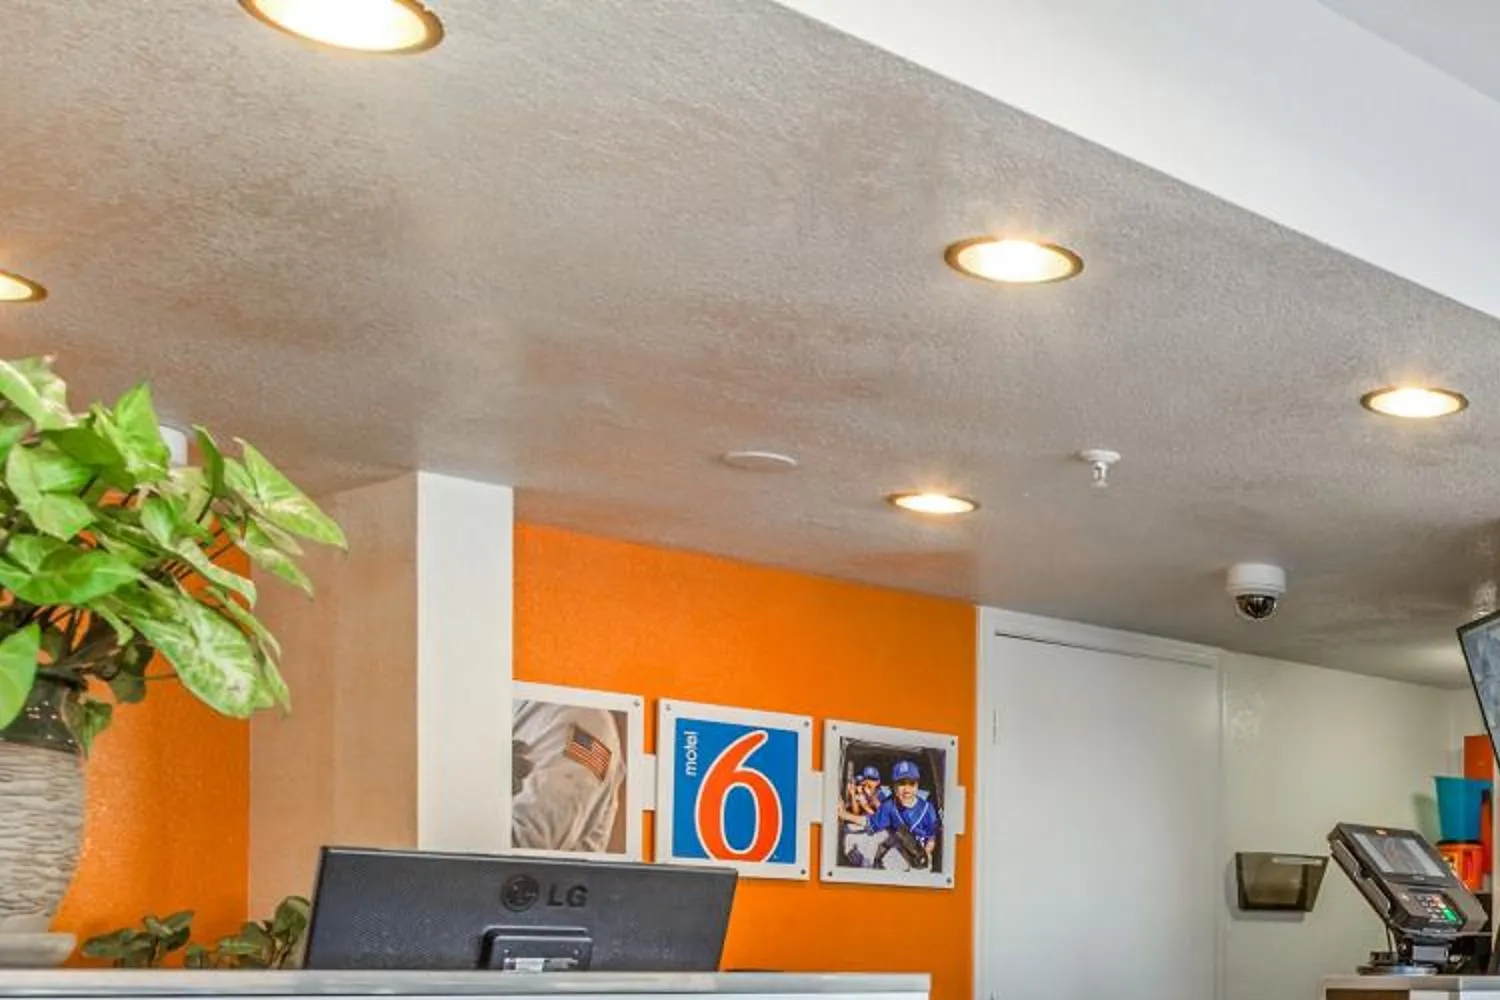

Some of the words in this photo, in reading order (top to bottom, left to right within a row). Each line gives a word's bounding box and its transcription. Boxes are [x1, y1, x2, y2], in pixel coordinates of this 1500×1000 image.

[684, 731, 699, 777] motel
[695, 730, 783, 864] 6
[546, 884, 589, 908] LG
